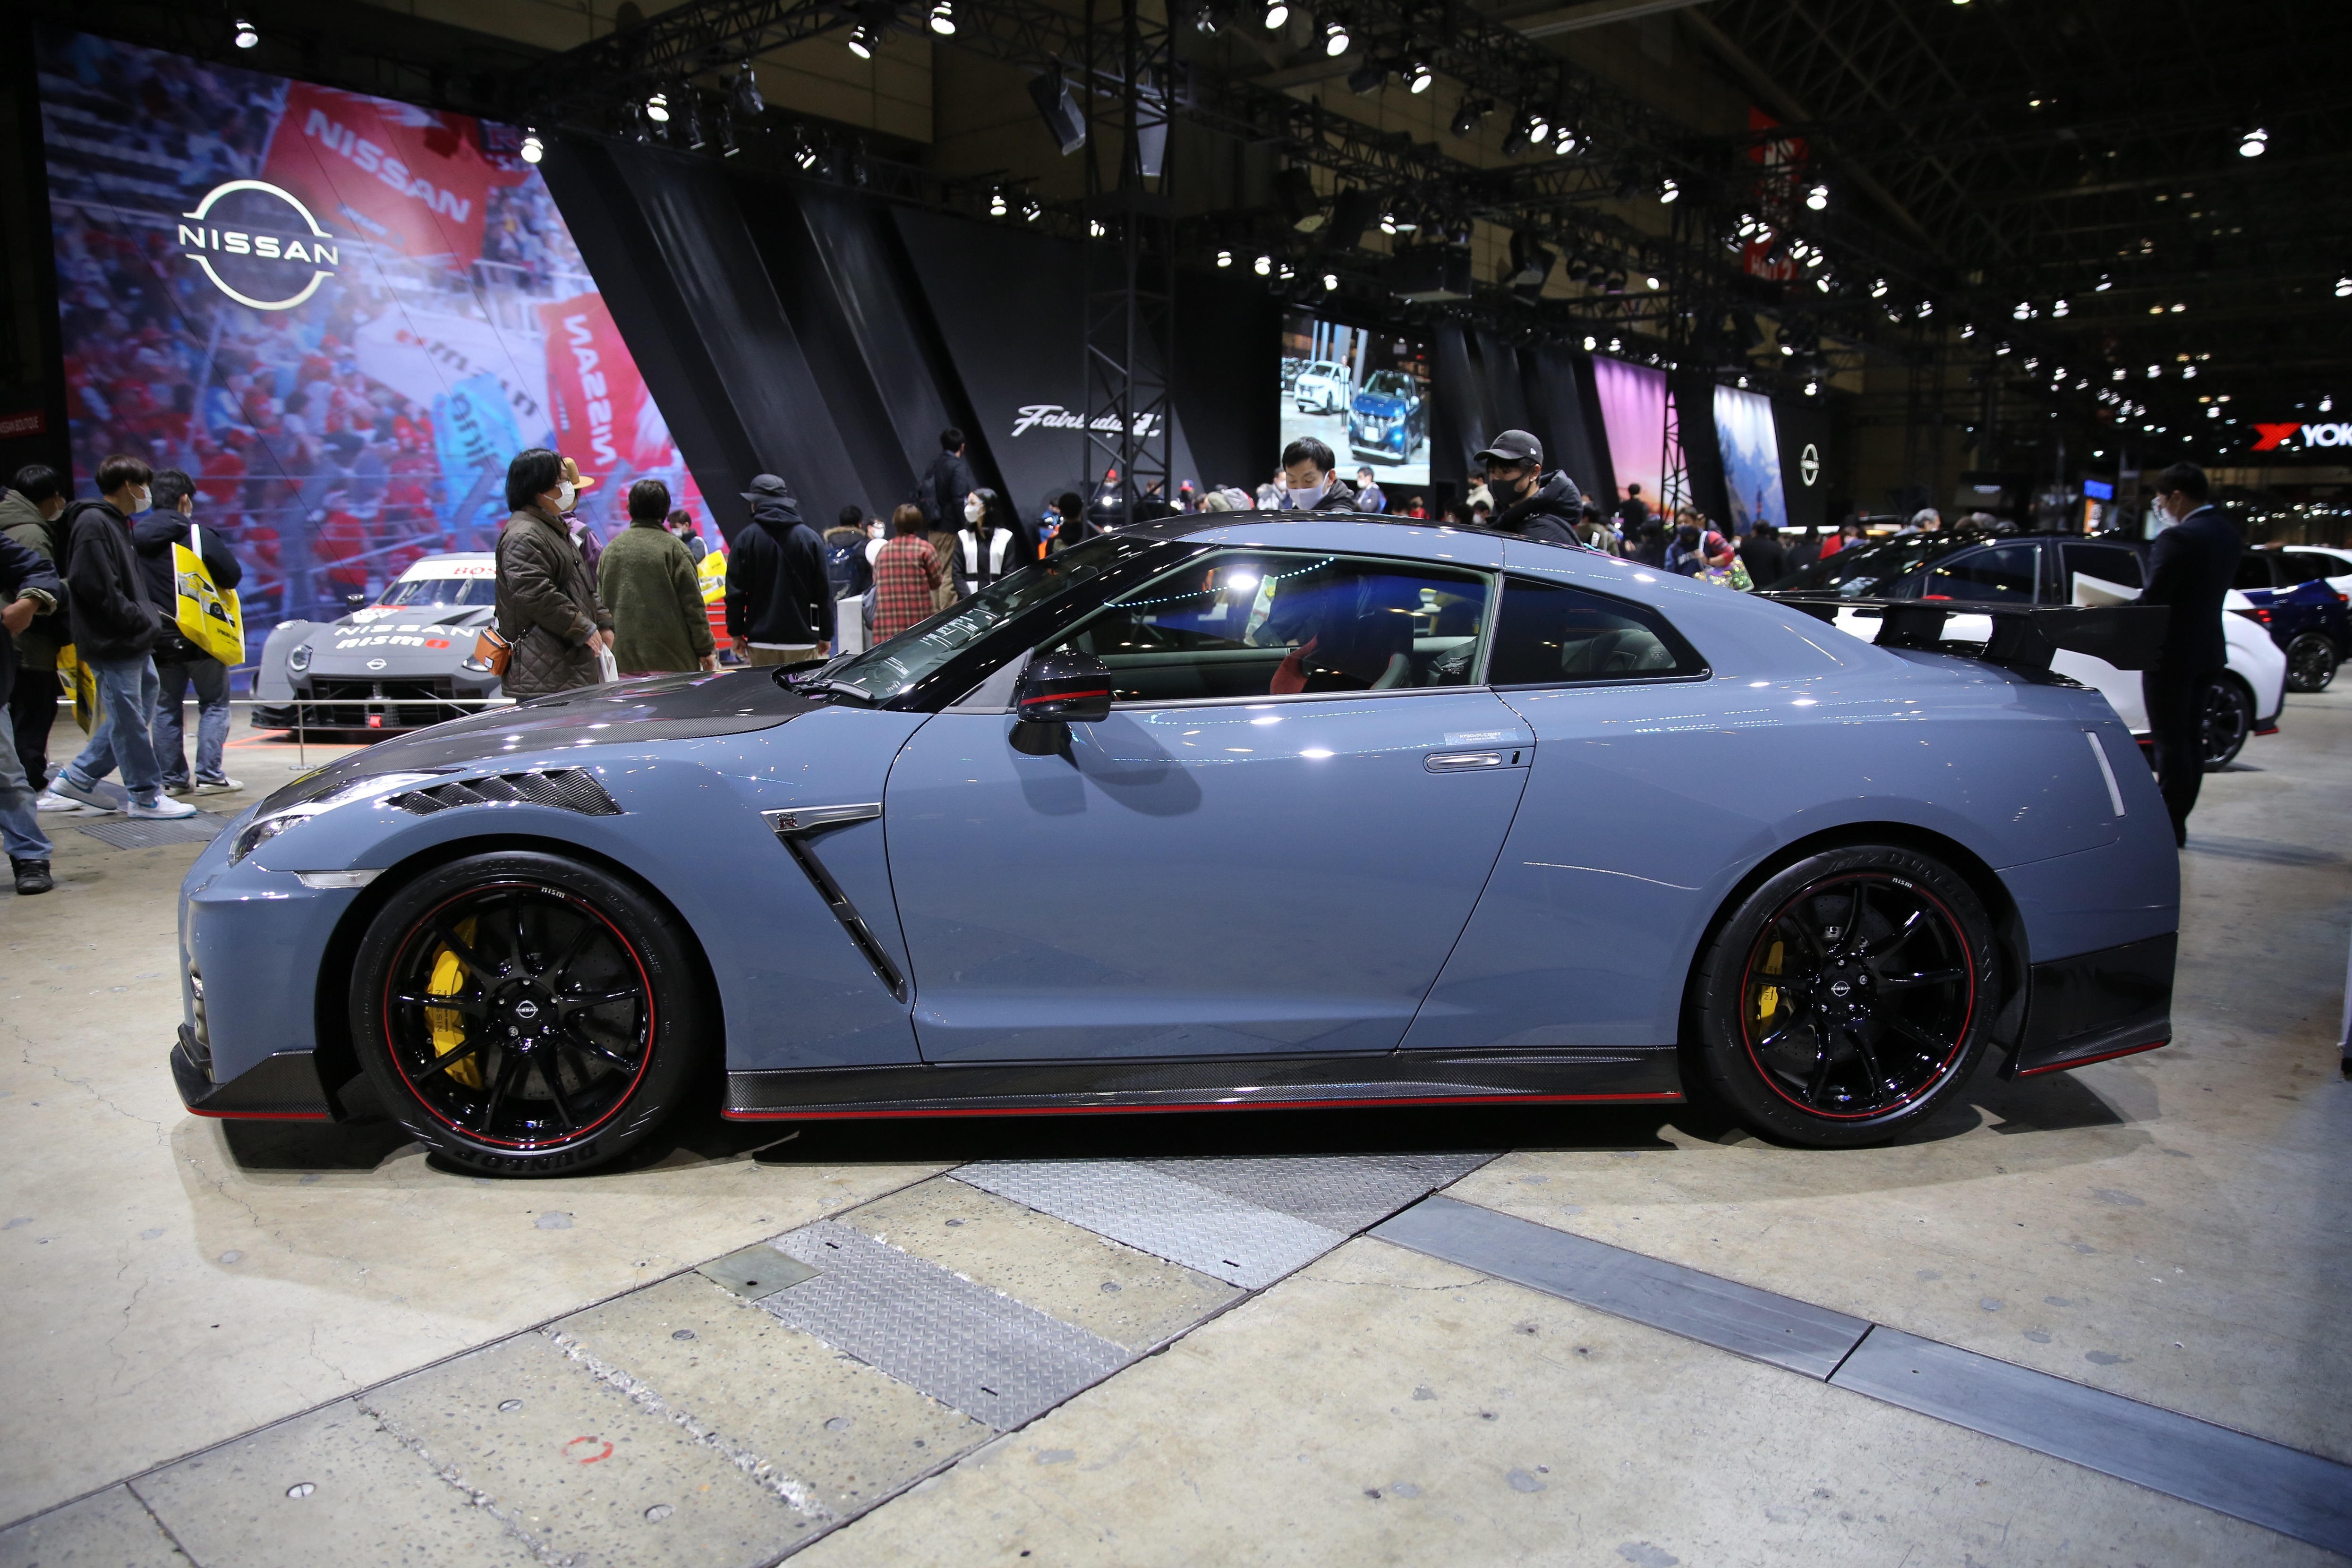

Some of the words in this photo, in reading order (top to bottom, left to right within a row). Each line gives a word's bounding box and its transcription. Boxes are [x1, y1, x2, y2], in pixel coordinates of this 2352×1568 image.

[305, 109, 470, 223] NISSAN
[178, 223, 339, 266] NISSAN
[2301, 422, 2352, 447] YOK
[334, 624, 475, 637] NISSAN
[335, 635, 450, 649] nismo
[453, 1140, 599, 1172] DUNLOP
